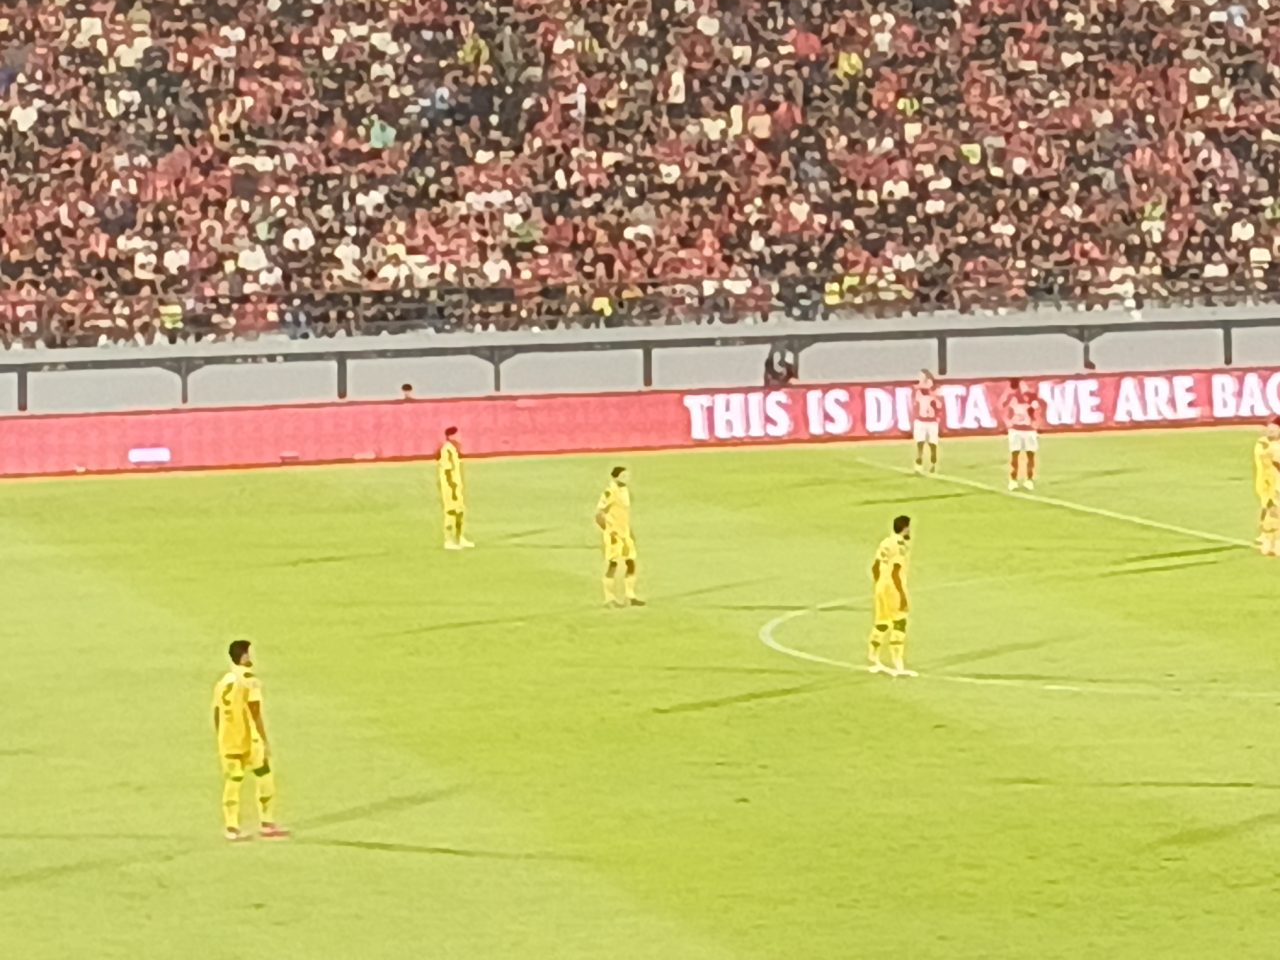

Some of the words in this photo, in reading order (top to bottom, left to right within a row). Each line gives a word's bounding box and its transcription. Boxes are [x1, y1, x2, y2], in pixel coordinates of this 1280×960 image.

[684, 390, 792, 440] THIS
[806, 388, 852, 435] IS
[864, 384, 998, 432] DITA
[1038, 377, 1104, 425] WE
[1113, 374, 1201, 422] ARE
